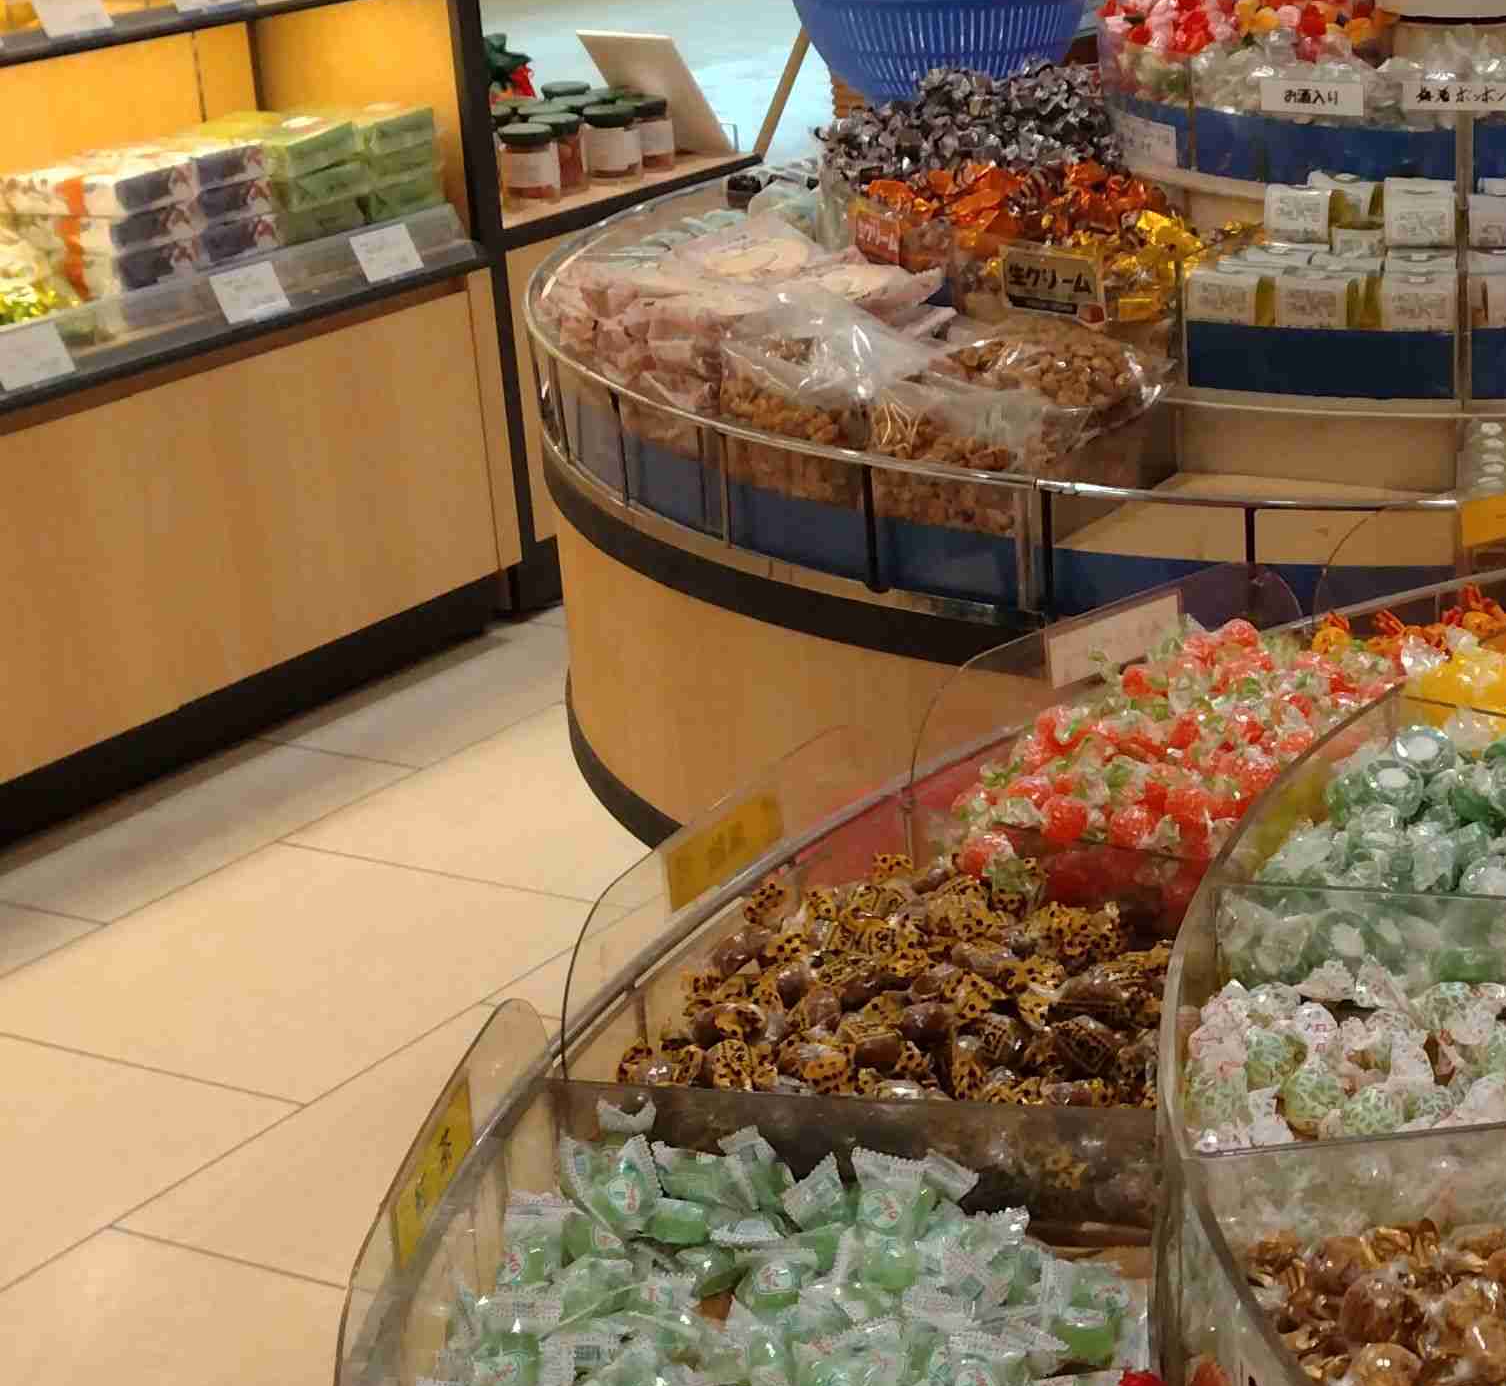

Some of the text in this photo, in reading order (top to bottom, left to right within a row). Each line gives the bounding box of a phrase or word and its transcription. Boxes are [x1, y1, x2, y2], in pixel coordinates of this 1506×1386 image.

[1283, 88, 1339, 105] お酒入り
[1008, 263, 1093, 294] 生クリーム
